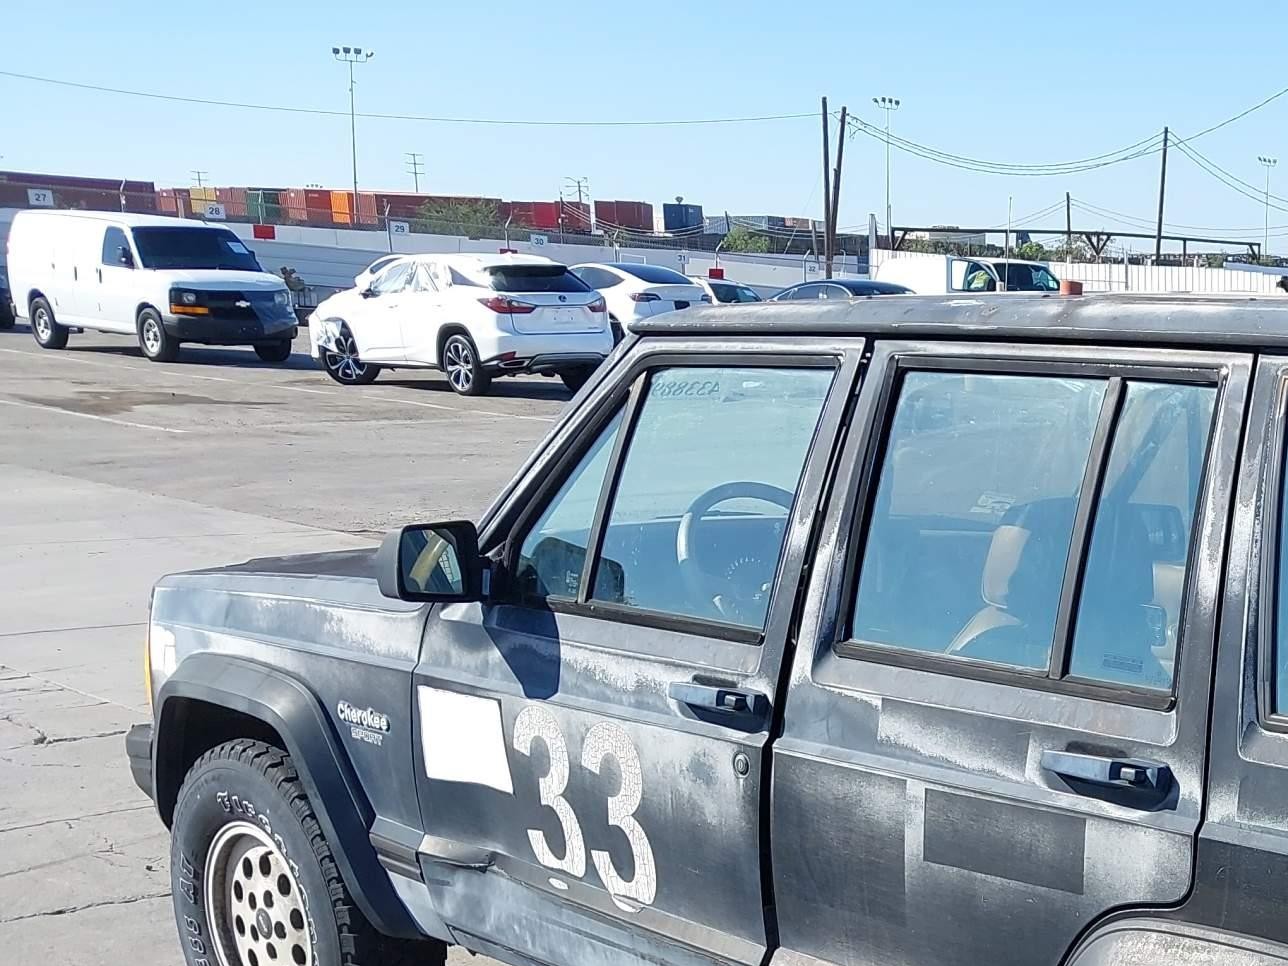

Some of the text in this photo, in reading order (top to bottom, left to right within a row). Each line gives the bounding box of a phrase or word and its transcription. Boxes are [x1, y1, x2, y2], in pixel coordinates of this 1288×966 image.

[34, 193, 47, 202] 27
[208, 206, 221, 216] 28
[394, 225, 405, 233] 29
[534, 237, 545, 246] 30
[337, 702, 389, 731] Cherokee
[513, 705, 658, 914] 33
[179, 850, 199, 905] AT
